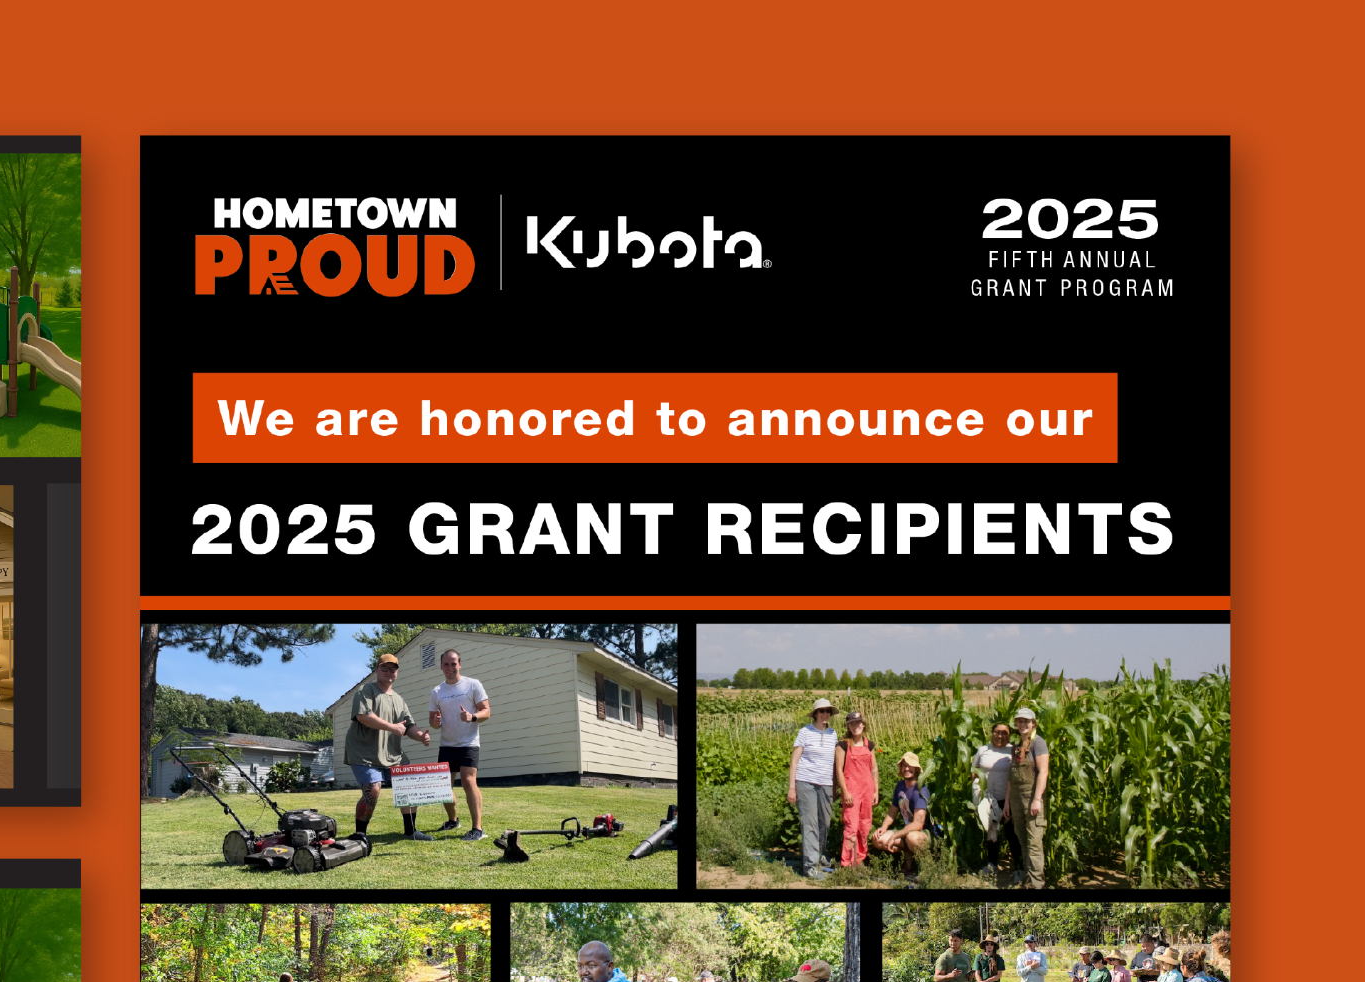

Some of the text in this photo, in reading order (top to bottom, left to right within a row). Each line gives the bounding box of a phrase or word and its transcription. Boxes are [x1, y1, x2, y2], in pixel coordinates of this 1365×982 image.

[214, 196, 457, 230] HOMETOWN
[982, 198, 1159, 240] 2025
[194, 233, 476, 298] PROUD
[989, 250, 1156, 268] FIFTH ANNUAL
[971, 278, 1173, 297] GRANT PROGRAM
[217, 399, 1093, 437] We are honored to announce our
[191, 501, 1173, 556] 2025 GRANT RECIPIENTS
